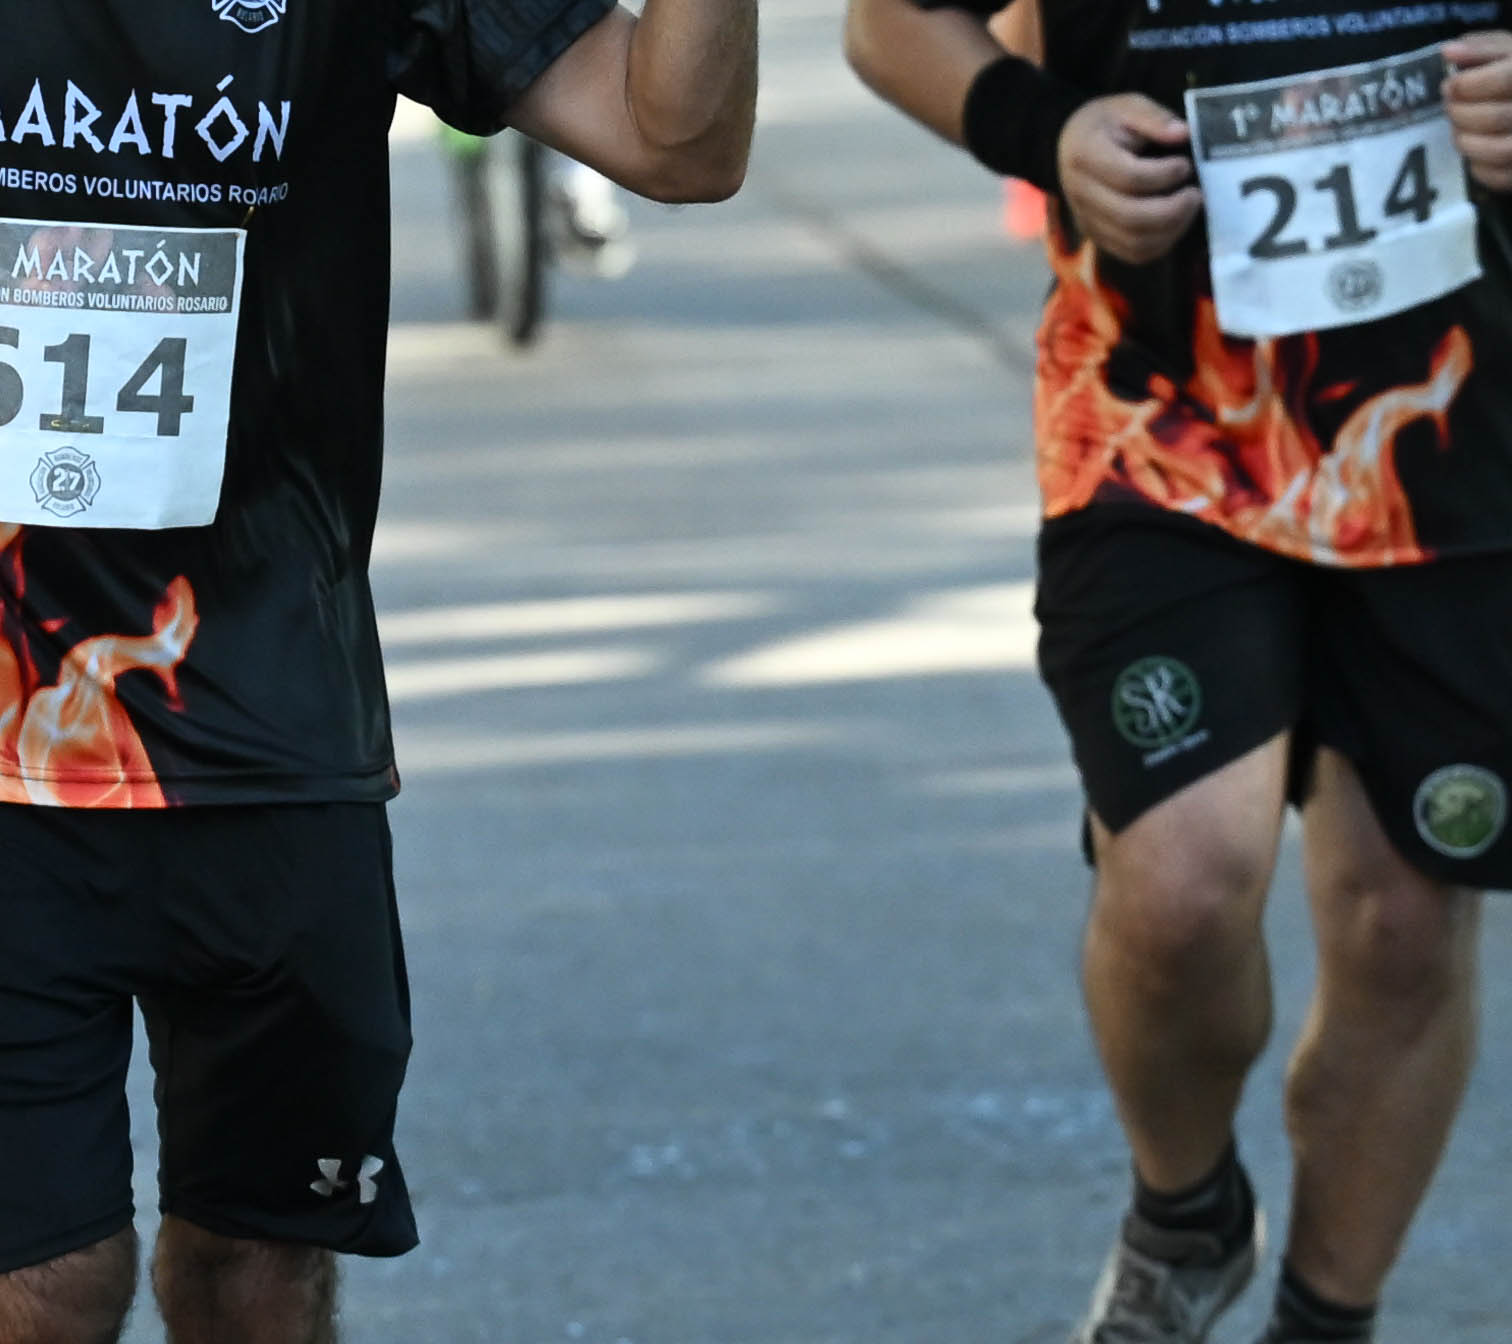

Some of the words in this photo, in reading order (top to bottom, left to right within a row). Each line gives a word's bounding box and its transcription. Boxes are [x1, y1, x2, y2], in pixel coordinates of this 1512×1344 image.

[1270, 67, 1427, 133] MARATÓN
[83, 175, 222, 203] VOLUNTARIOS
[1238, 143, 1439, 260] 214
[10, 238, 202, 288] MARATÓN
[13, 287, 85, 308] BOMBEROS
[87, 291, 175, 312] VOLUNTARIOS
[176, 295, 228, 312] ROSARIO
[52, 467, 82, 492] 27
